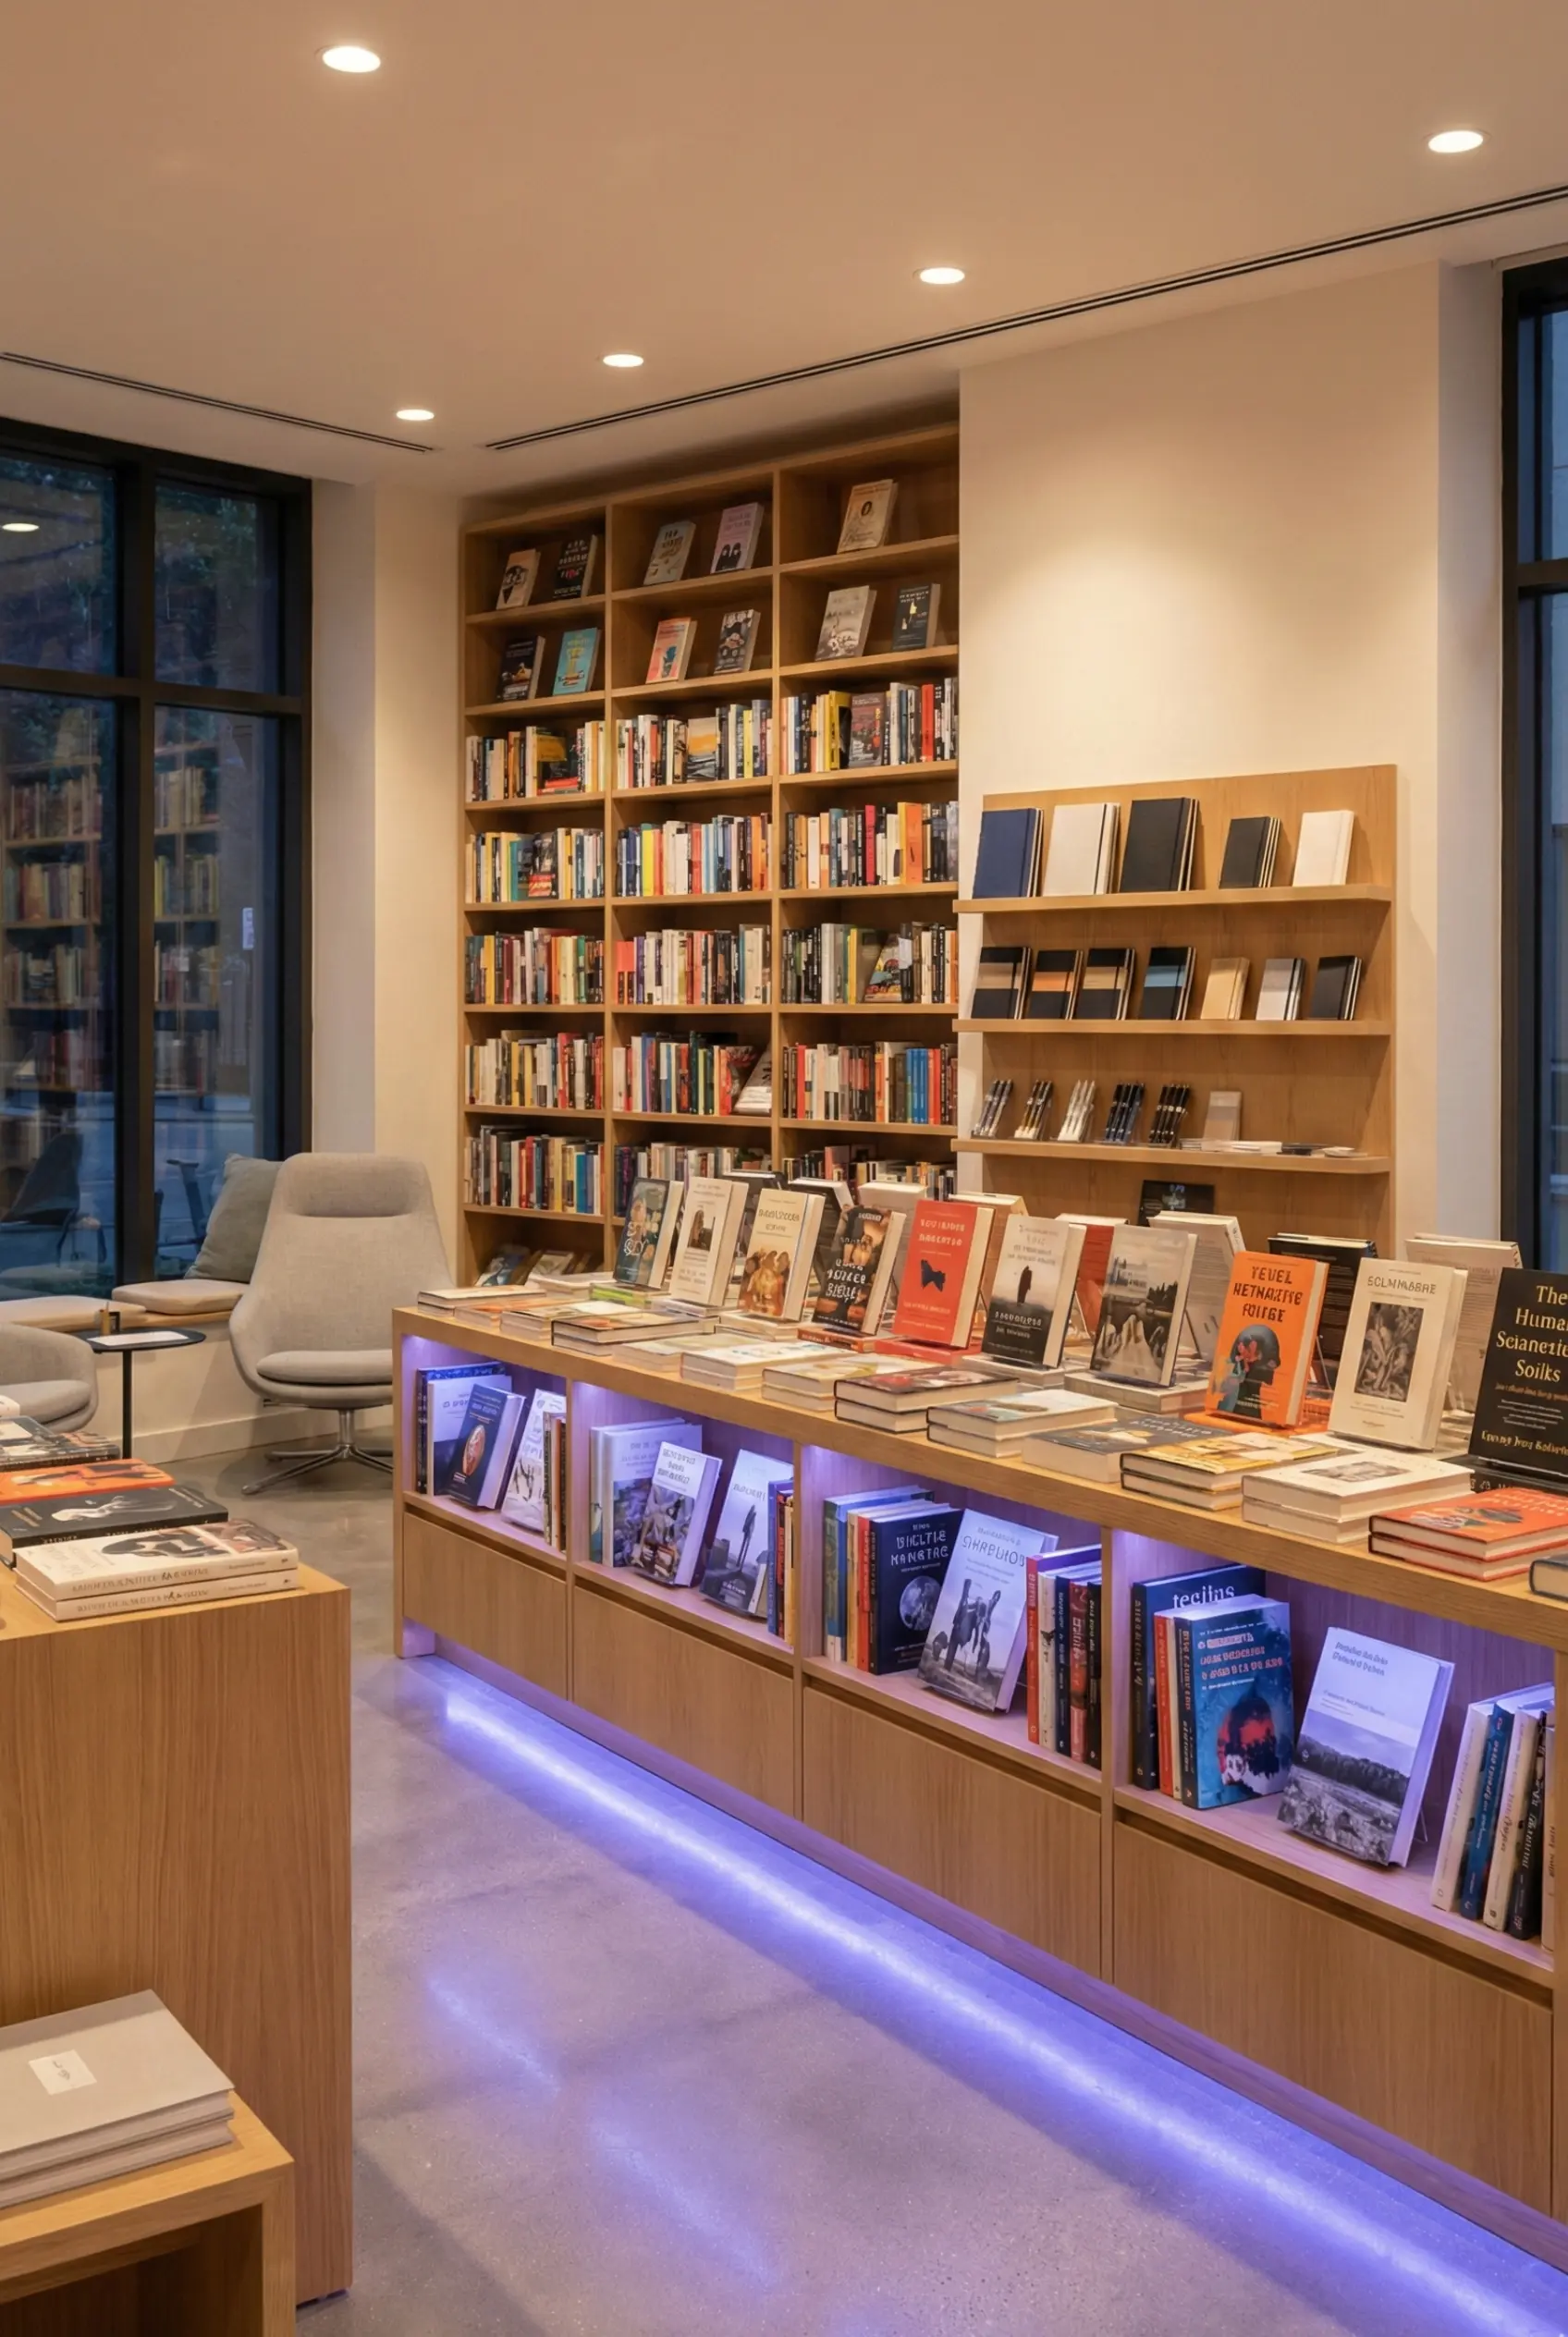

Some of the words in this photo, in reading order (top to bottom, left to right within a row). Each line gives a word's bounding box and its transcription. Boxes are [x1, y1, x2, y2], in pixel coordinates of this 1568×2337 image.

[1536, 1285, 1568, 1305] The
[1515, 1307, 1568, 1331] Huma
[1514, 1359, 1562, 1383] Soilks
